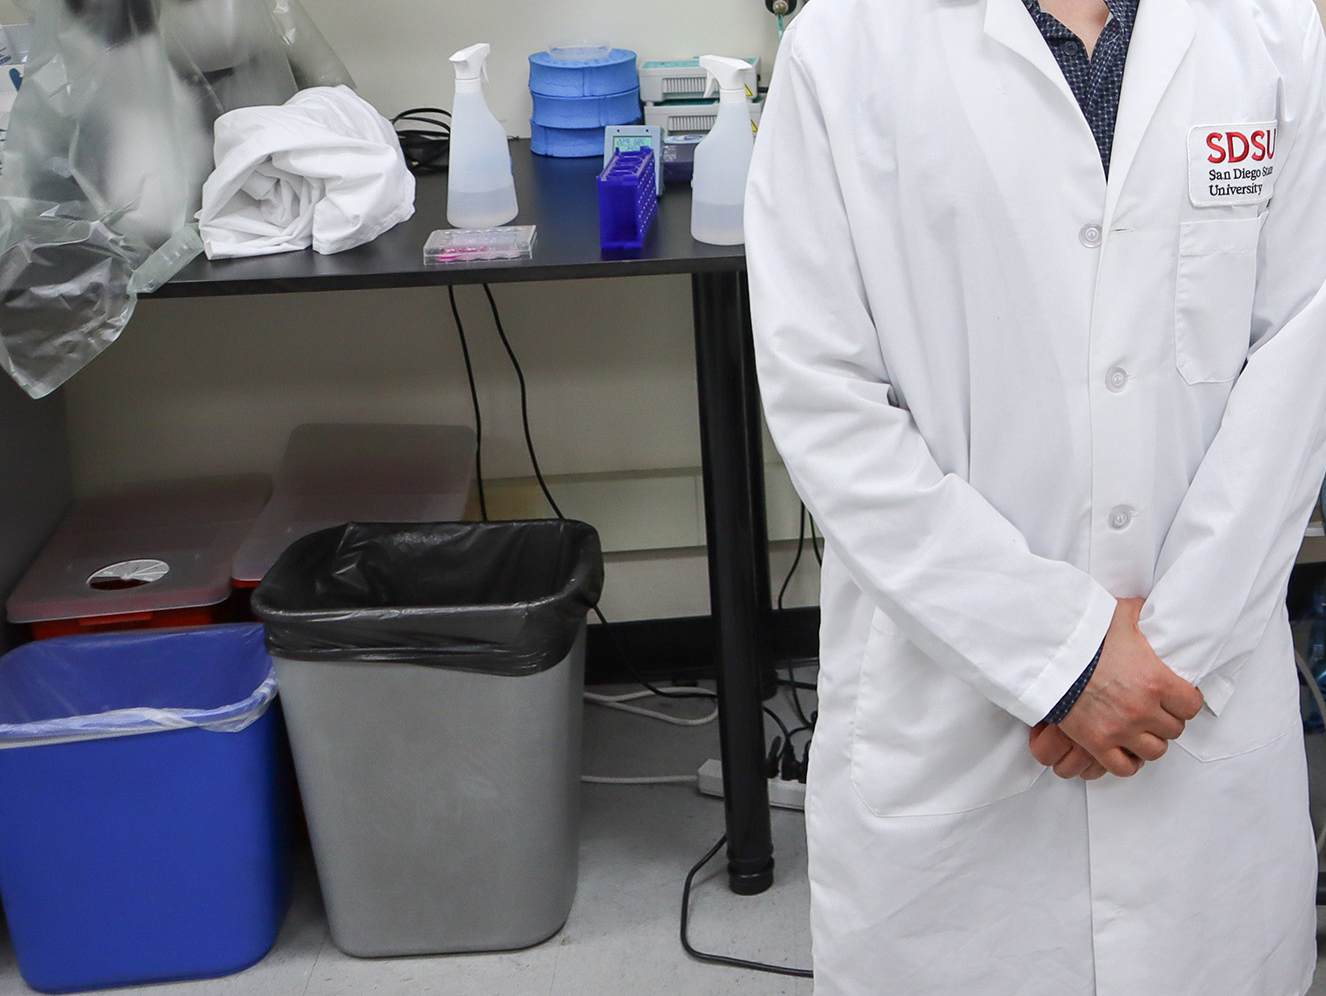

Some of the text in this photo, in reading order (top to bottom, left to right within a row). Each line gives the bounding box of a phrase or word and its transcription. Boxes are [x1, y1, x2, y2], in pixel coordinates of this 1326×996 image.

[1206, 128, 1277, 163] SDSU
[1209, 169, 1231, 181] San
[1233, 168, 1261, 181] Diego
[1209, 183, 1263, 196] University
